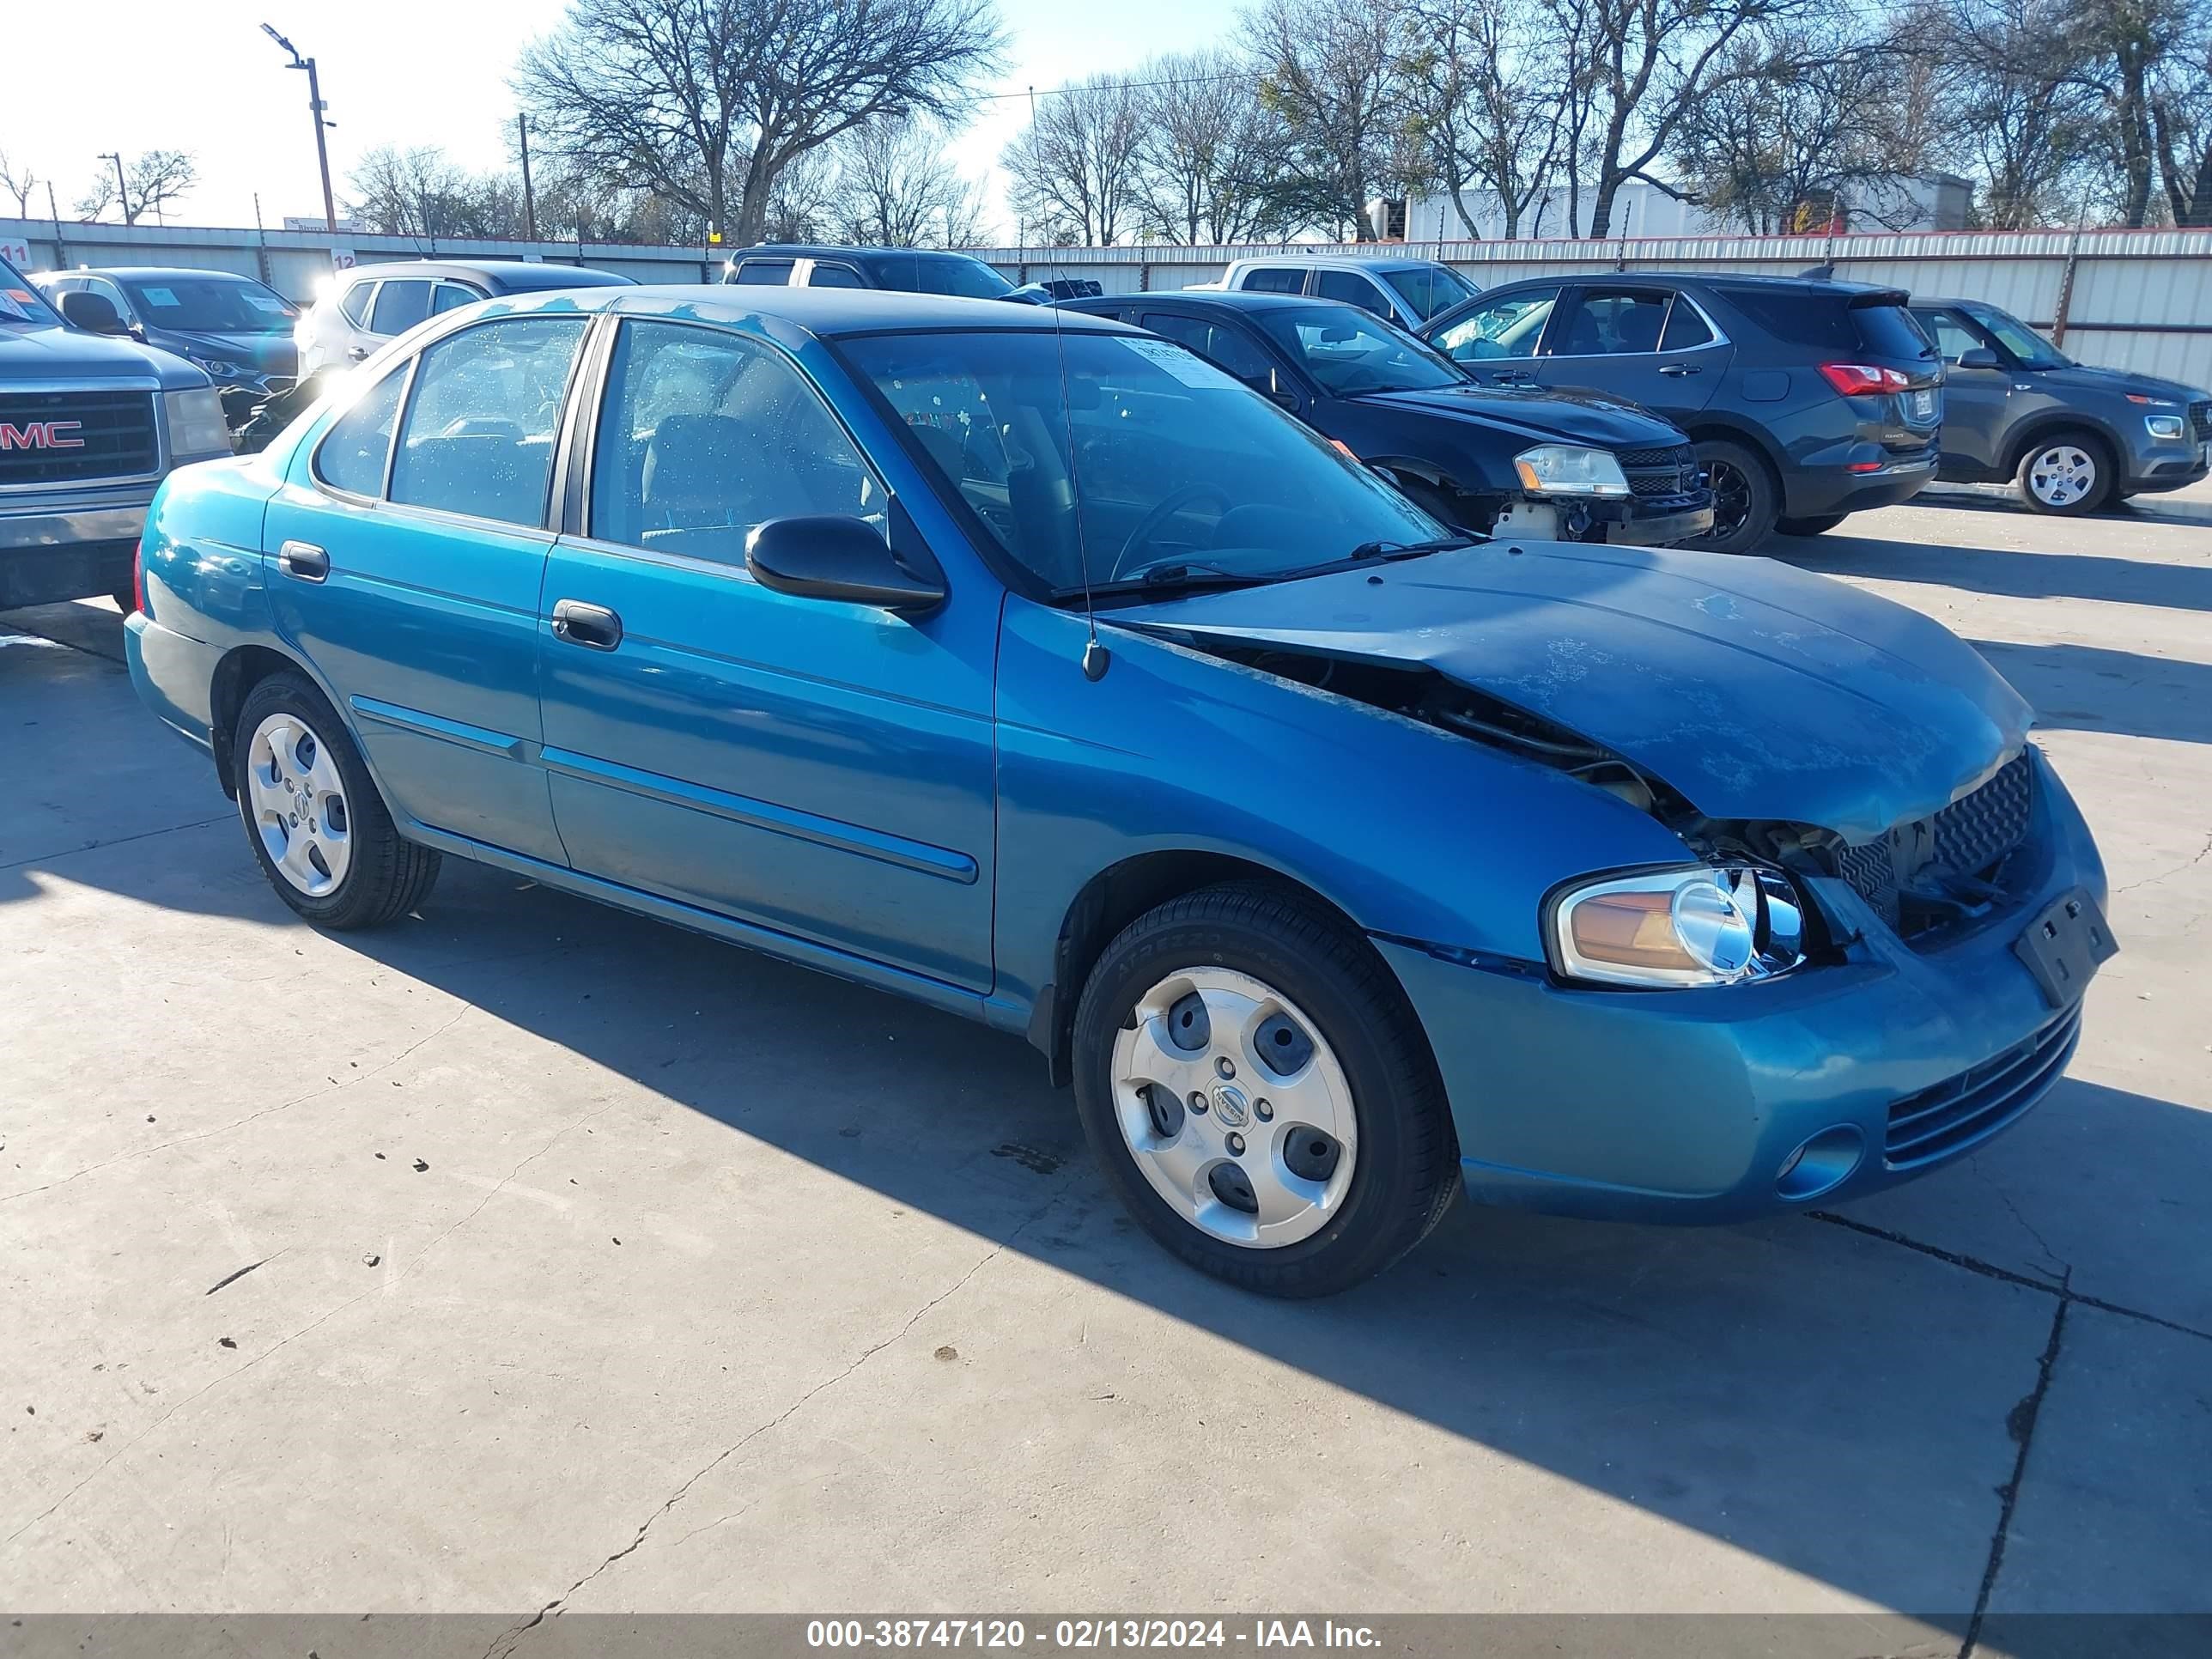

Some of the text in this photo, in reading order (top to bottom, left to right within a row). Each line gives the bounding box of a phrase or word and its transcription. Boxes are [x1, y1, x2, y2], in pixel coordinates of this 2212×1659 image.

[1, 246, 26, 261] 11
[335, 255, 355, 270] 12
[0, 421, 85, 450] MC
[1216, 1092, 1243, 1121] NISSAN
